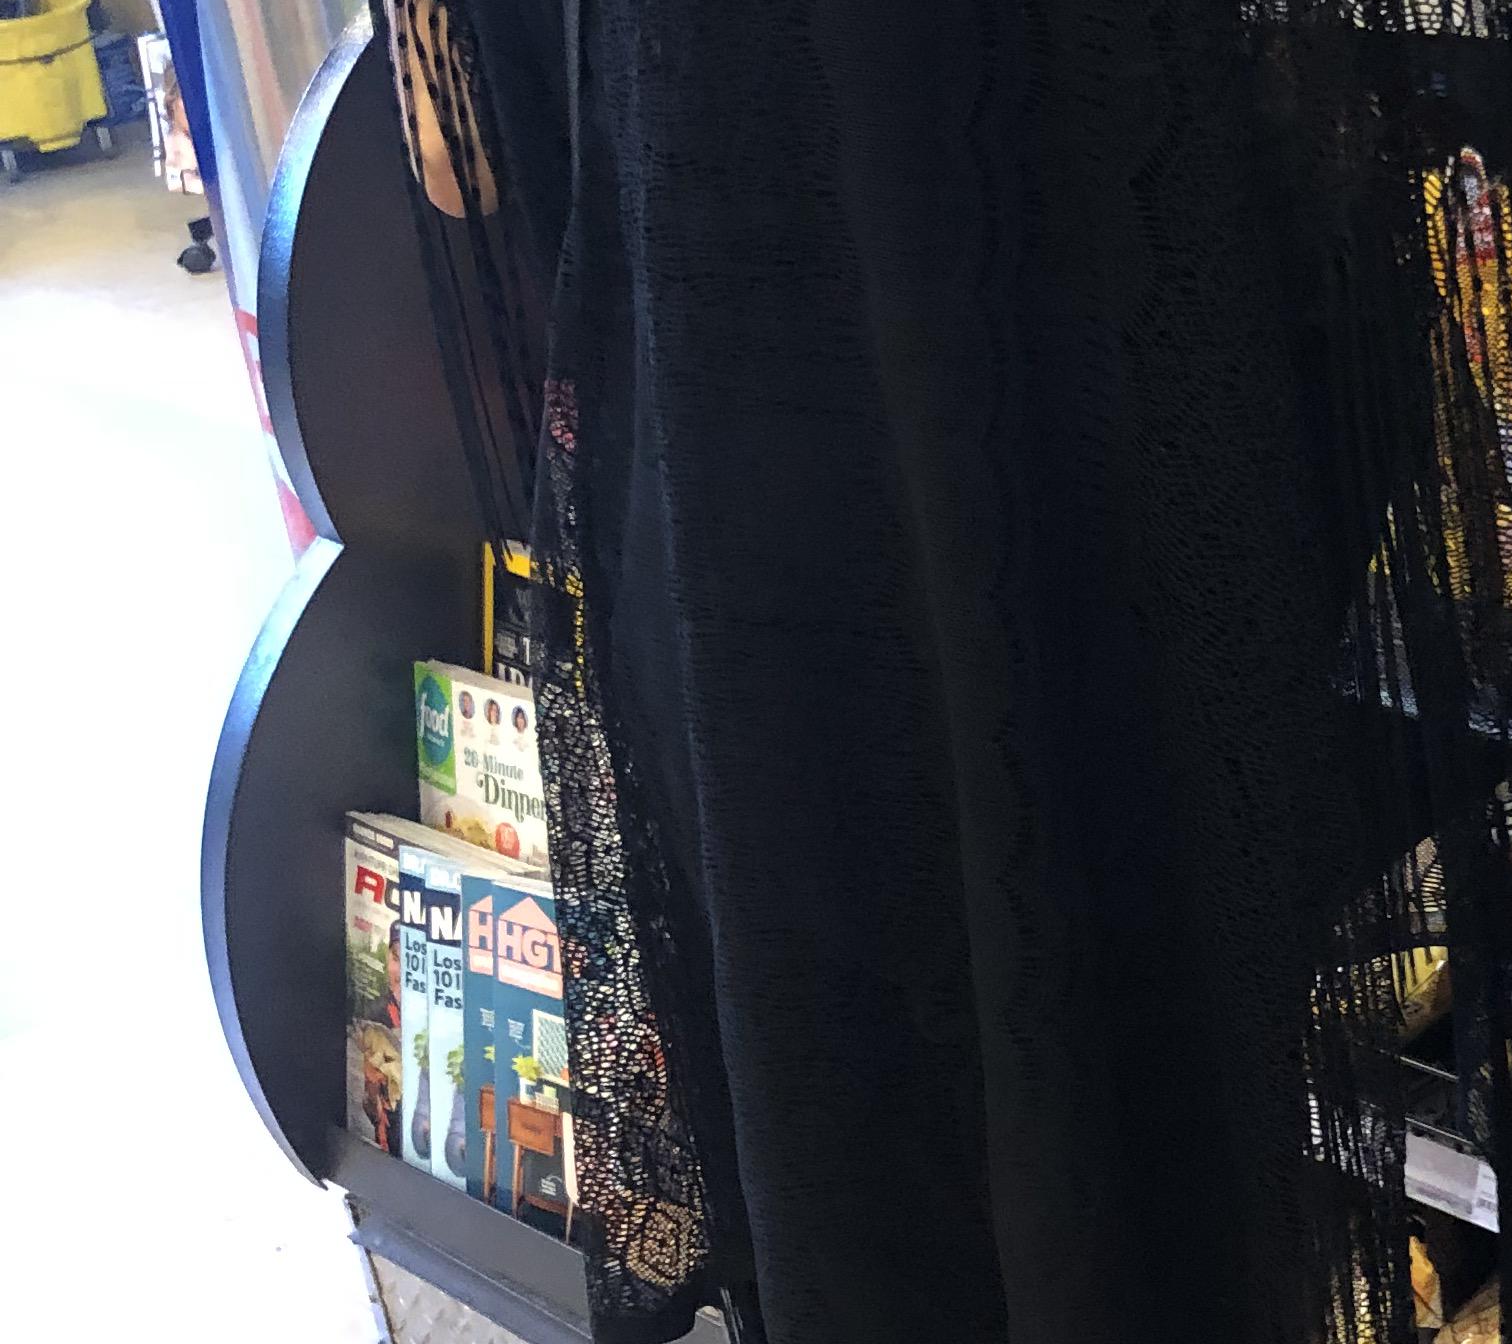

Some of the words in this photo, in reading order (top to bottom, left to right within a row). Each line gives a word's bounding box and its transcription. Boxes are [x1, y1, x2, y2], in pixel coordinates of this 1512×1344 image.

[418, 693, 450, 739] food
[432, 948, 463, 972] Los
[433, 987, 464, 1010] Fas
